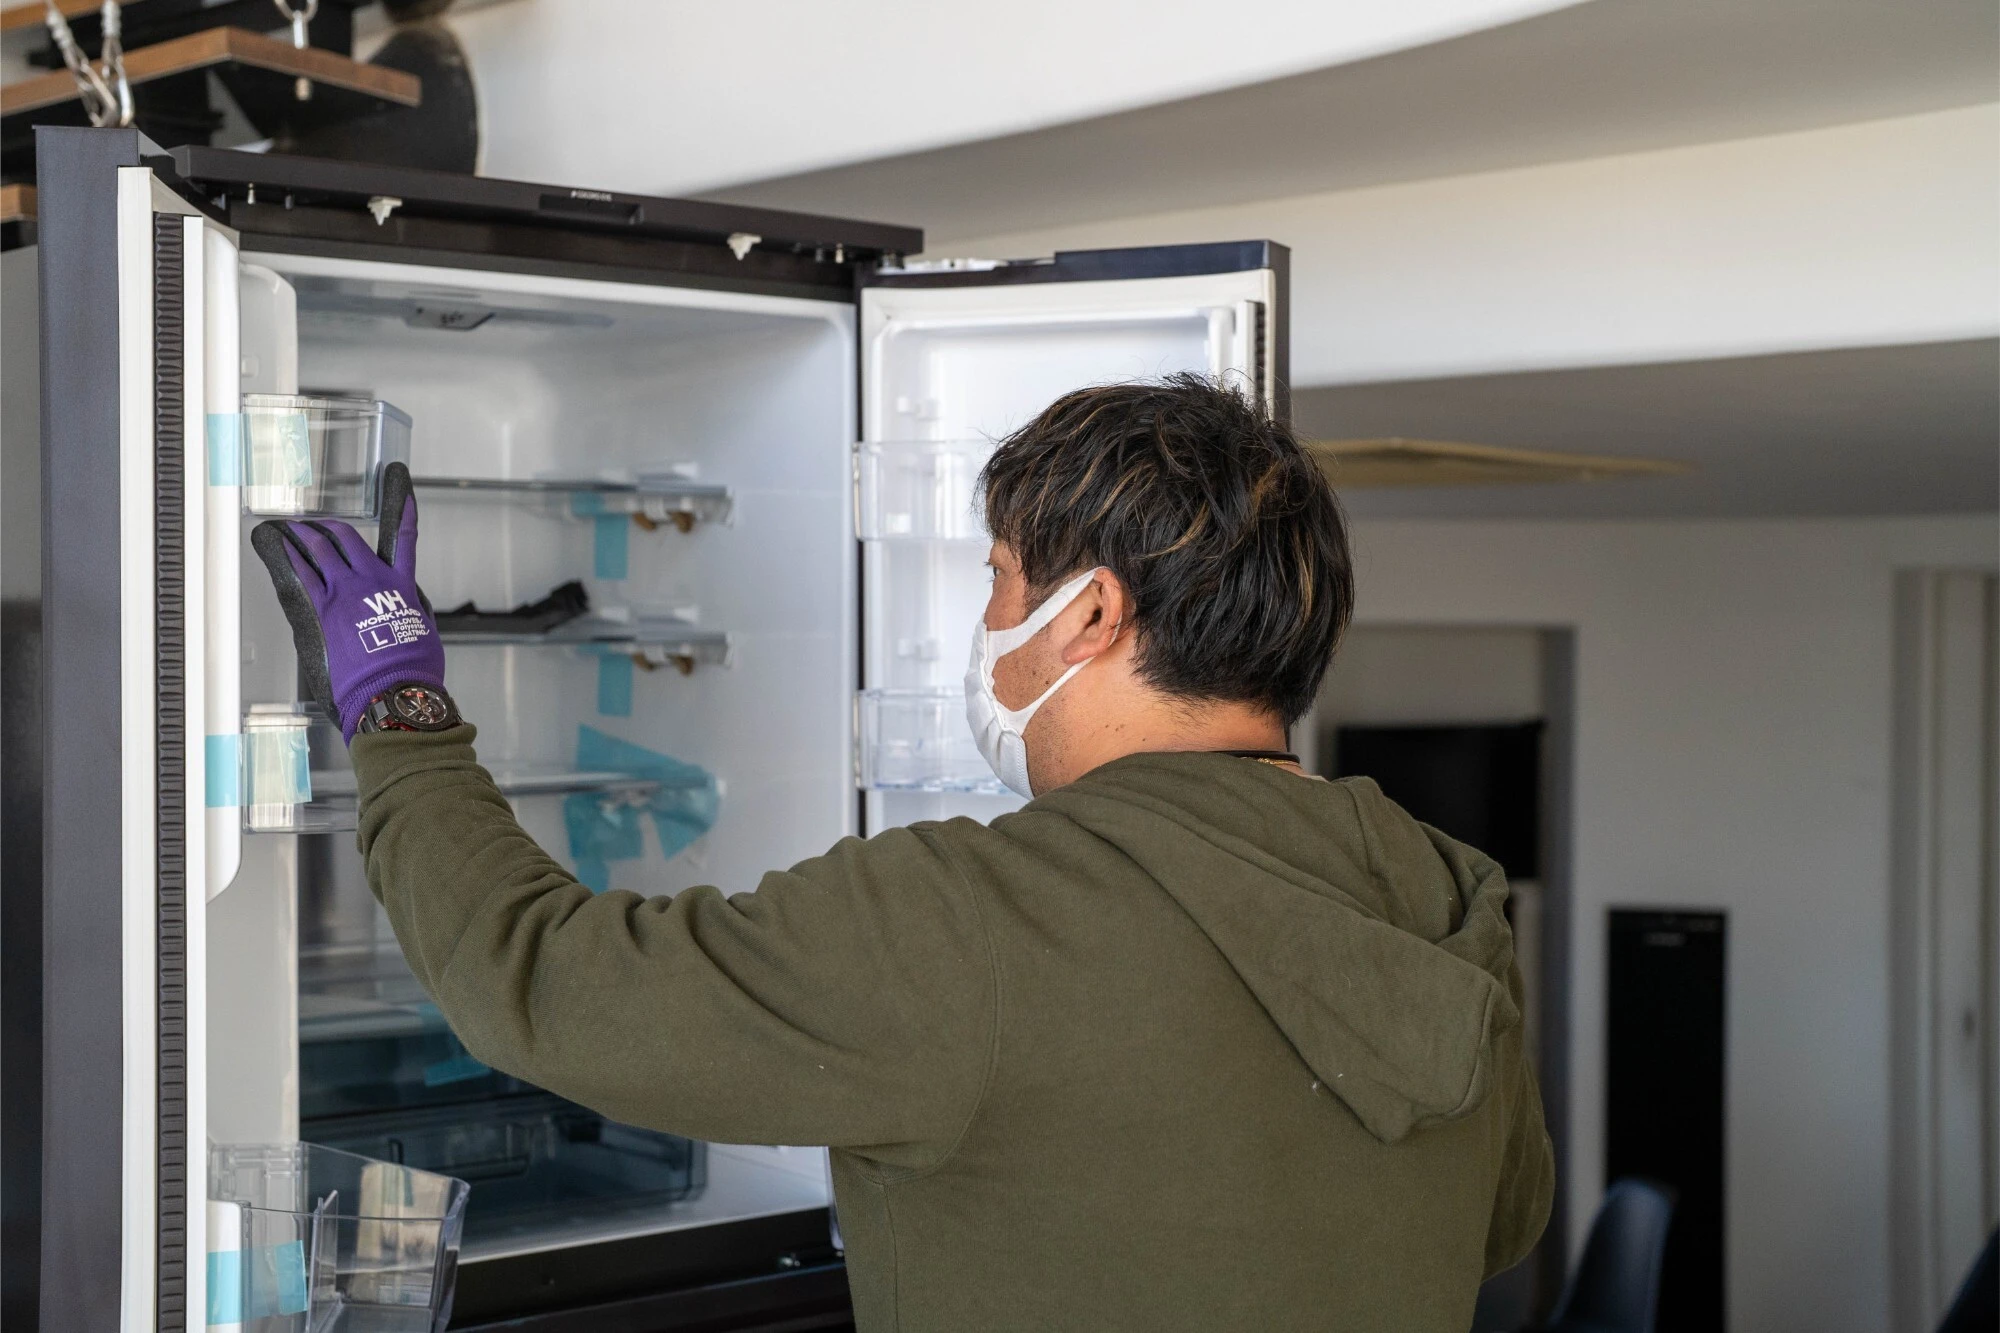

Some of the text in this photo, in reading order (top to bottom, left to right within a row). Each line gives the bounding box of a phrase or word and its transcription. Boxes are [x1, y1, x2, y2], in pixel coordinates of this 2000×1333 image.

[363, 590, 407, 615] WH
[355, 608, 421, 630] WORK HARD
[371, 631, 388, 646] L
[398, 636, 418, 644] Latex
